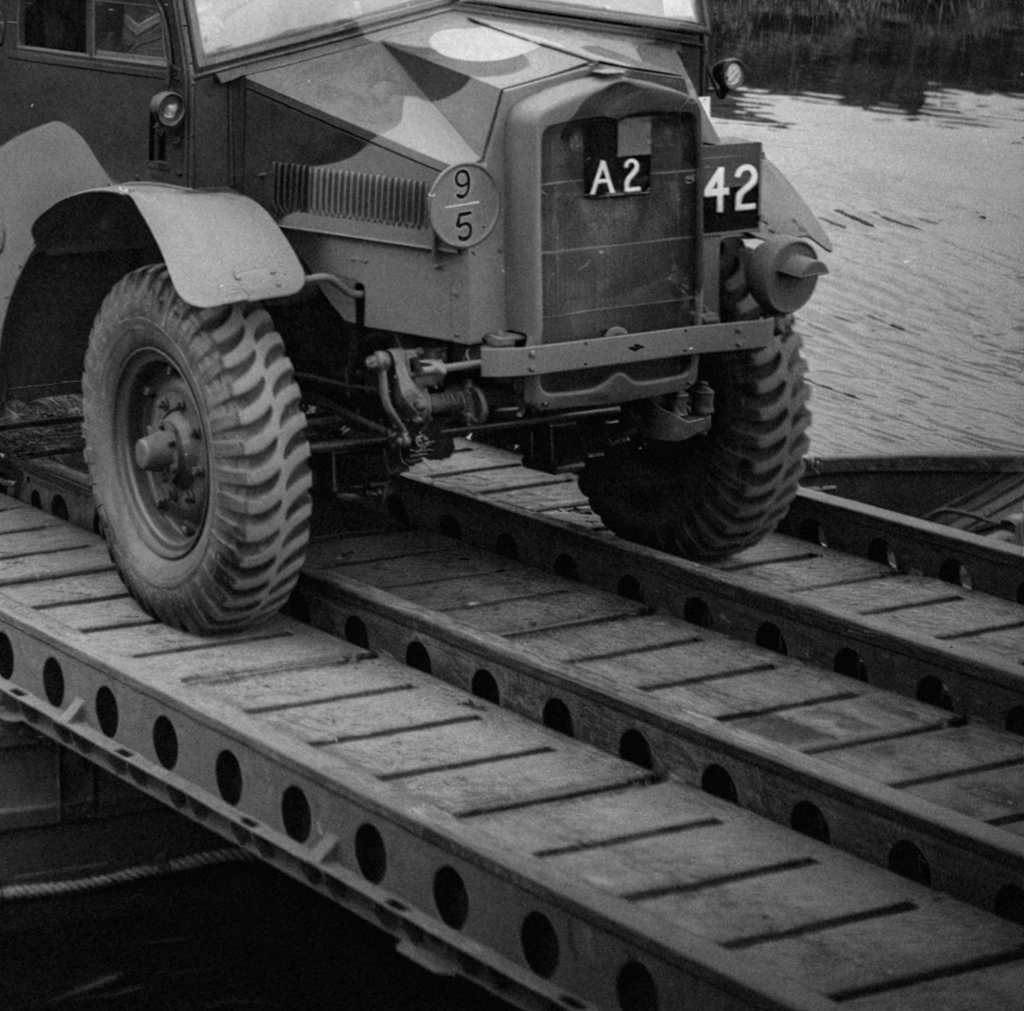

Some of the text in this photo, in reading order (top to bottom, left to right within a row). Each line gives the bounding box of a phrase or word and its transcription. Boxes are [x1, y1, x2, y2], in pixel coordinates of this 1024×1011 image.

[455, 170, 471, 199] 9
[703, 163, 759, 213] 42
[456, 211, 473, 242] 5
